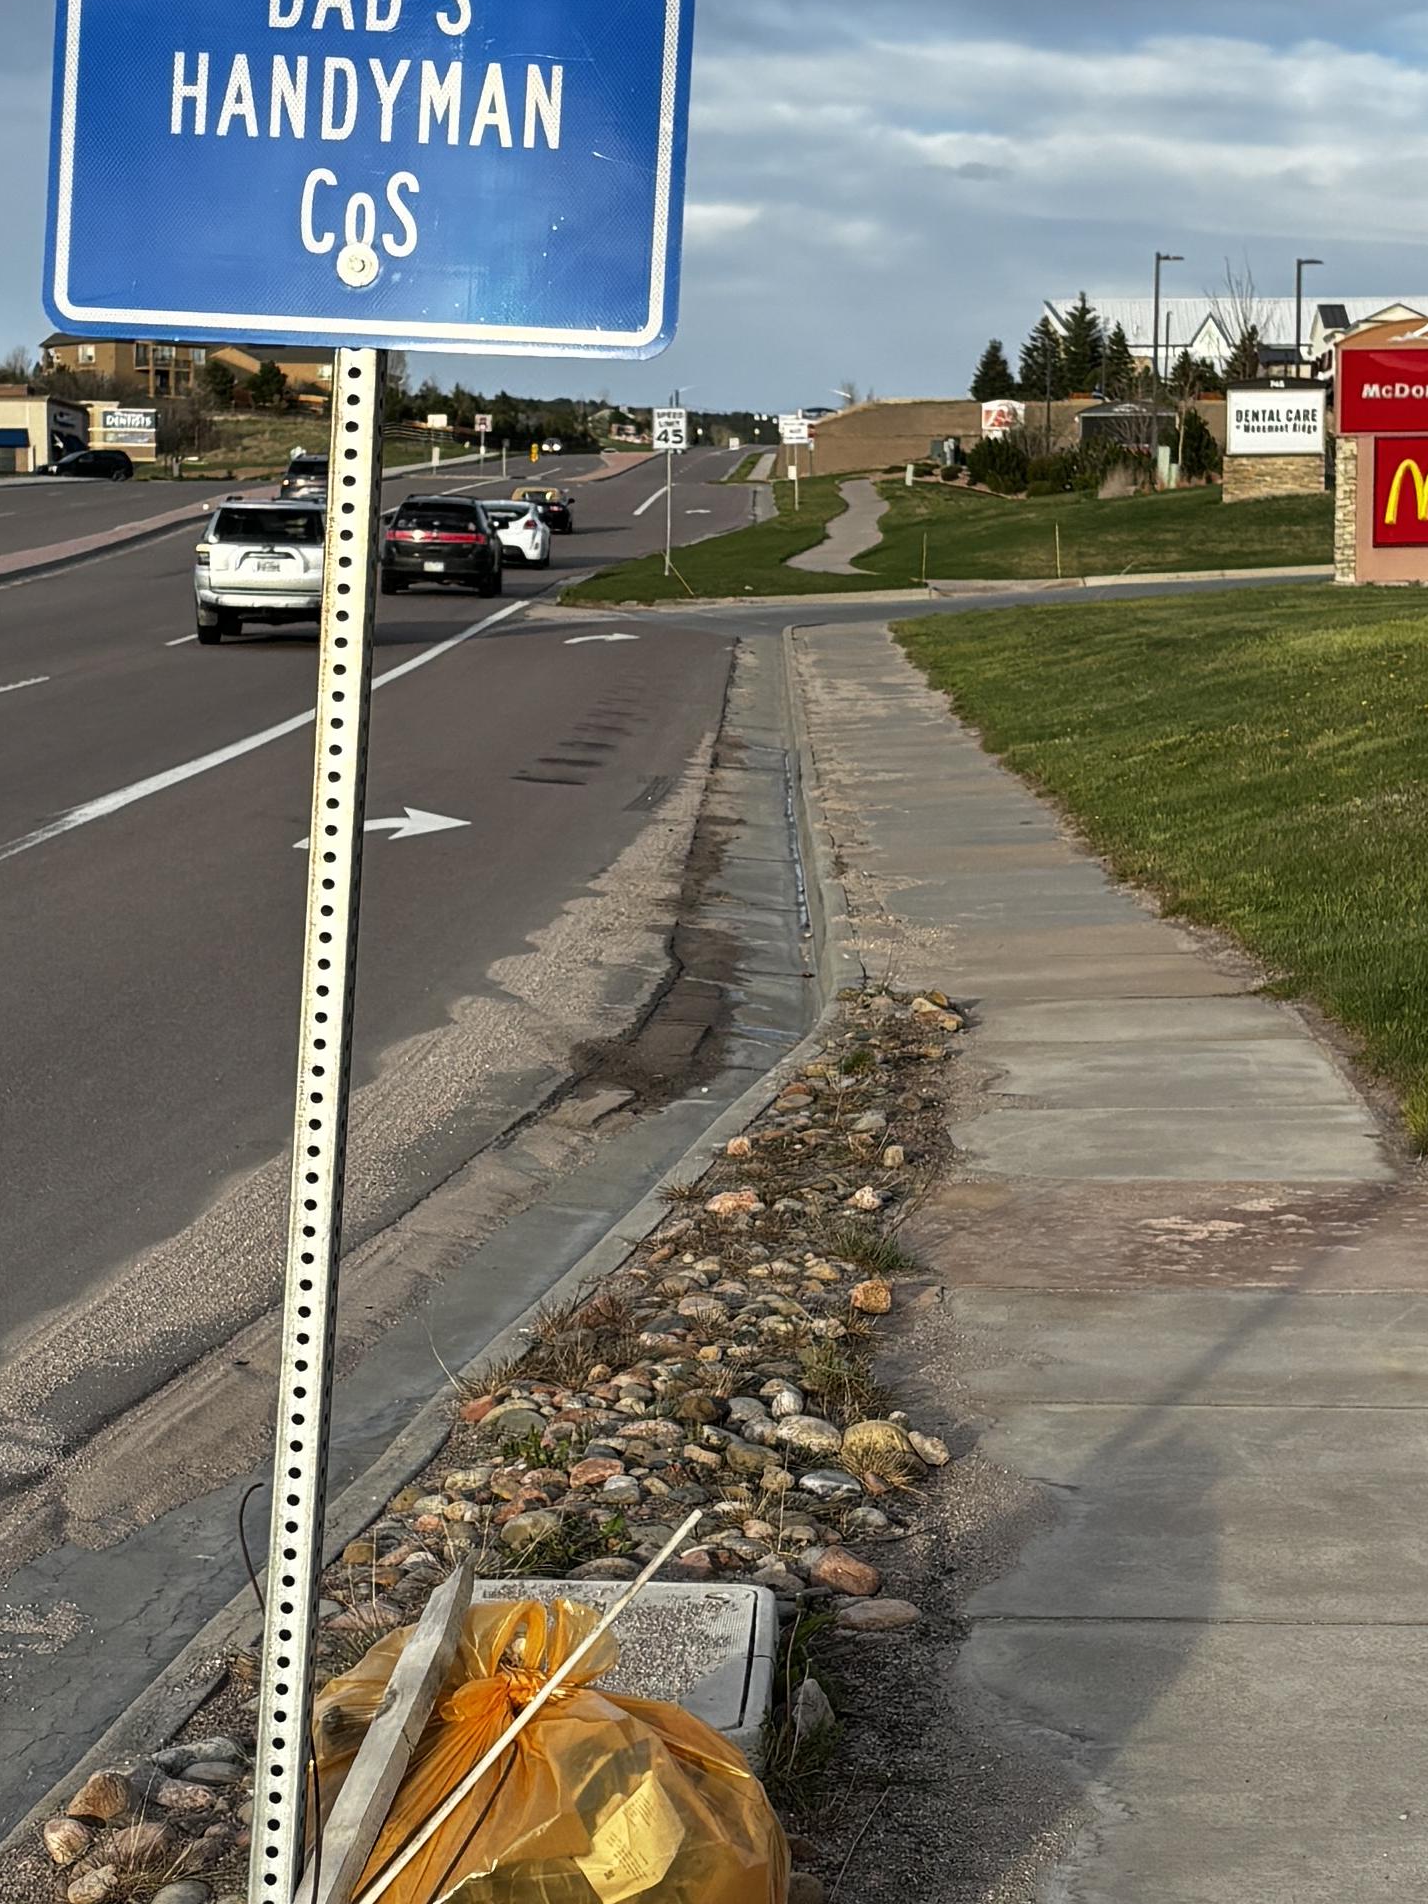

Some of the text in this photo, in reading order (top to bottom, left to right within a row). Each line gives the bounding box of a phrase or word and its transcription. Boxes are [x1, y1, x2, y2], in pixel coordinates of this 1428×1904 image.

[170, 51, 564, 150] HANDYMAN
[1235, 408, 1318, 423] DENTAL CARE
[655, 428, 684, 444] 45
